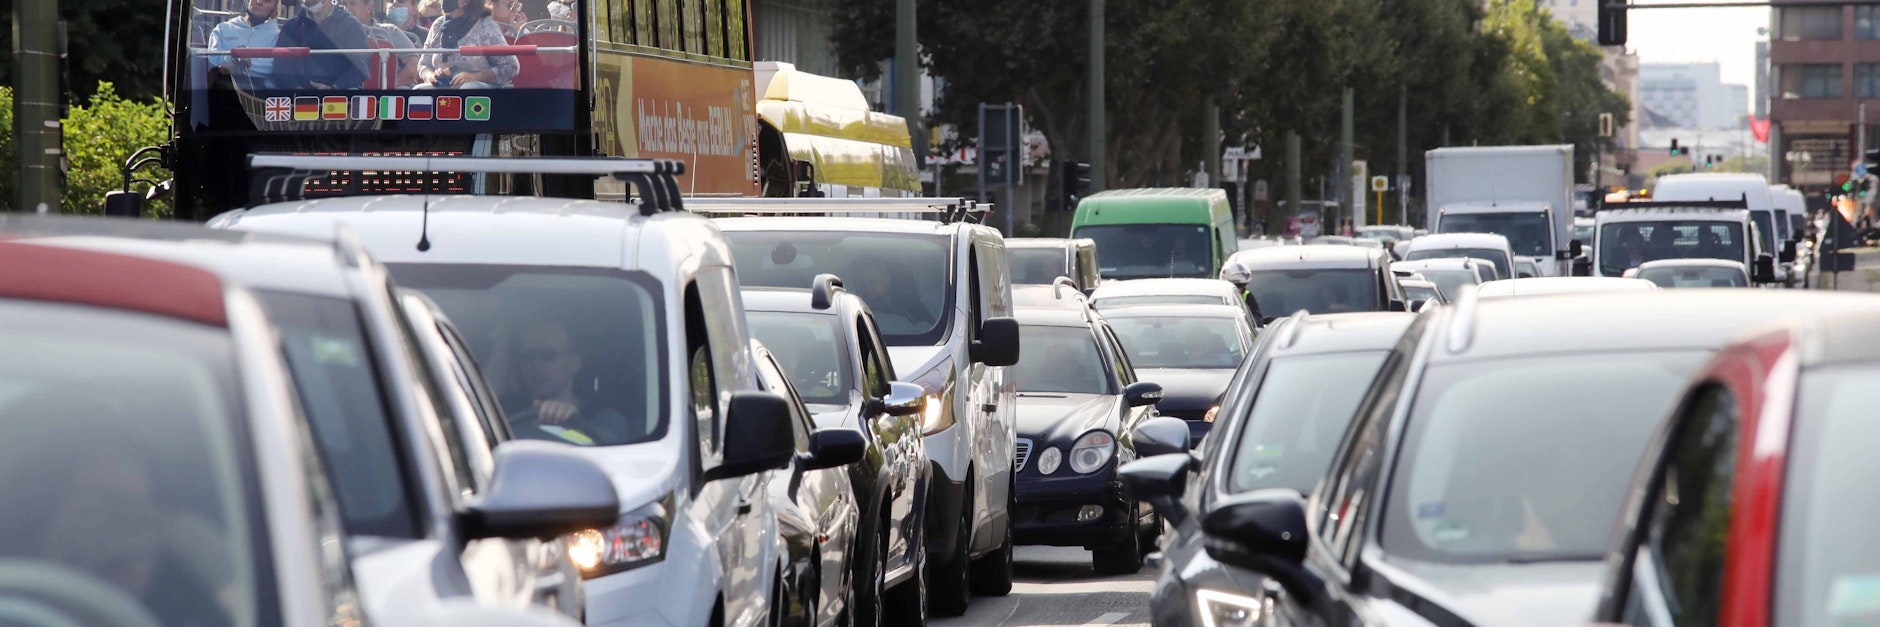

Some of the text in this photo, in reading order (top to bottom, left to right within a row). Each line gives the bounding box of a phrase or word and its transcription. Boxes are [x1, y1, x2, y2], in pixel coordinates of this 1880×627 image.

[637, 97, 664, 153] Mache
[664, 100, 678, 154] das
[676, 101, 697, 155] Beste
[697, 120, 710, 156] aus
[708, 105, 735, 156] BERLIN
